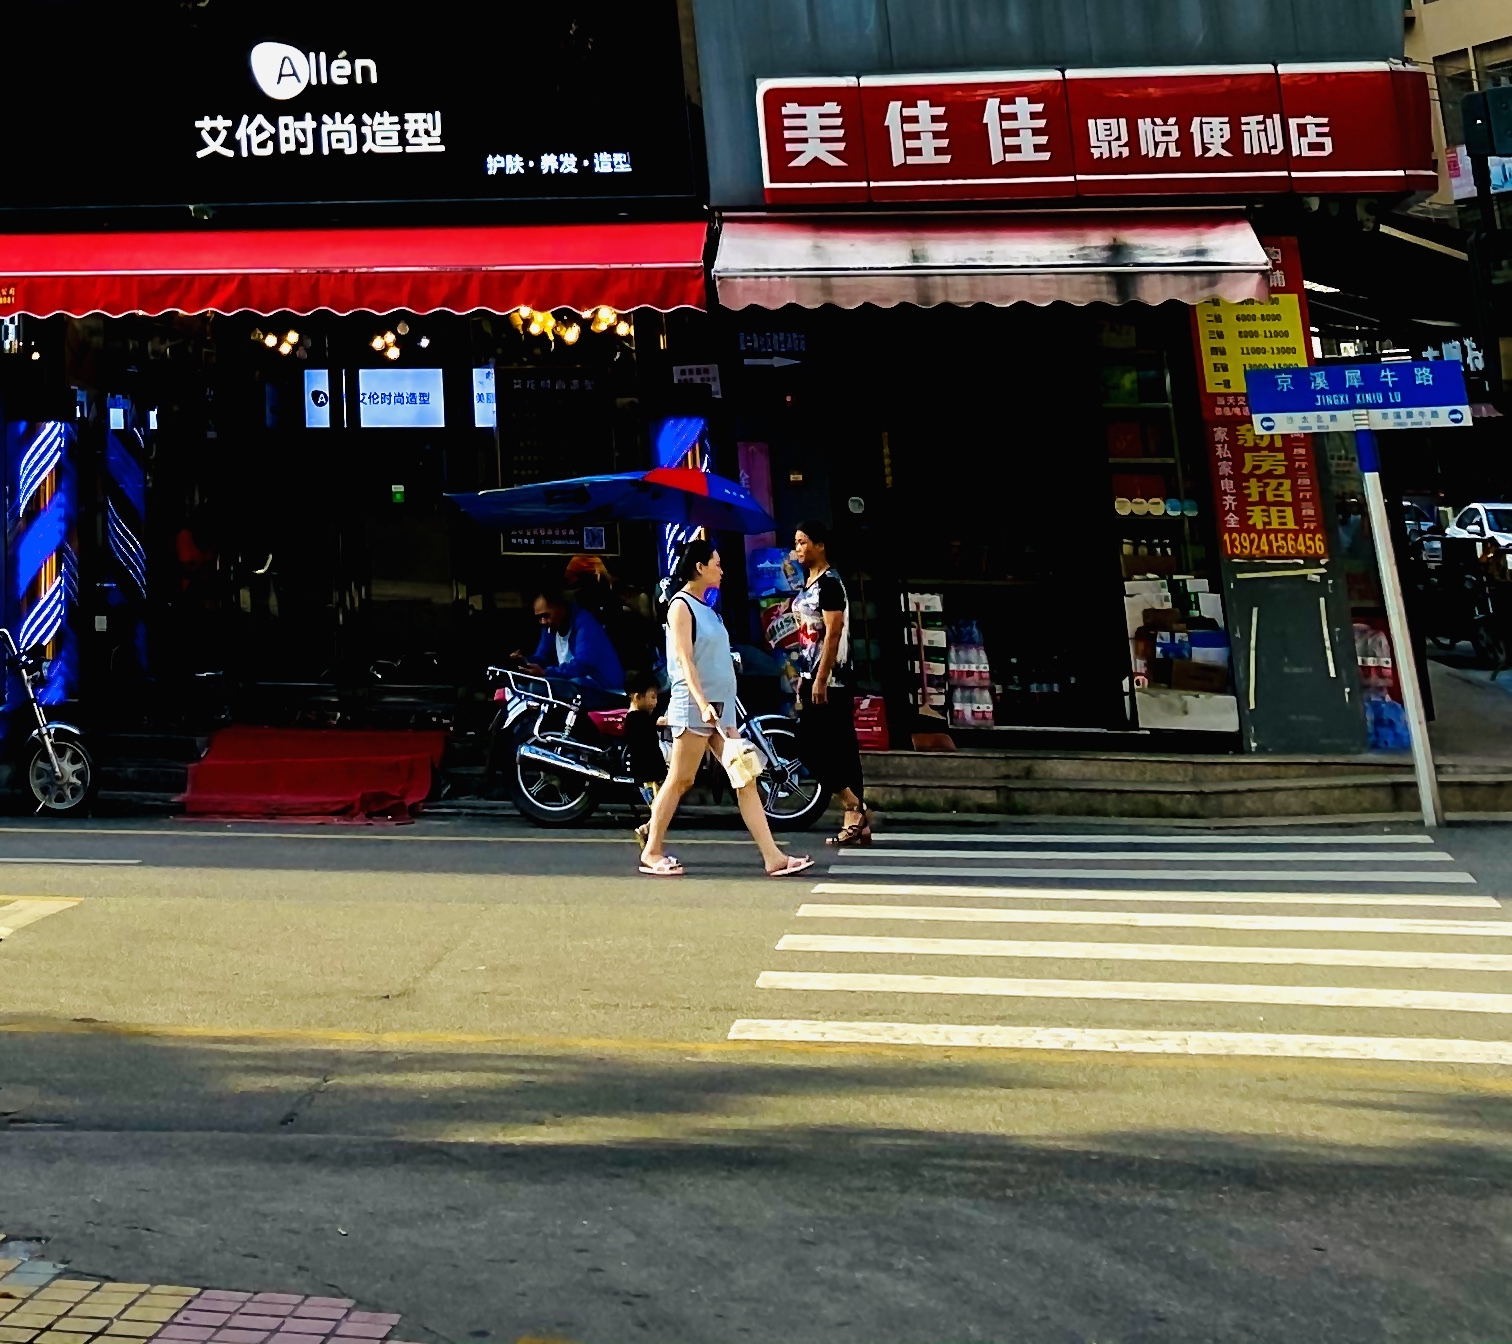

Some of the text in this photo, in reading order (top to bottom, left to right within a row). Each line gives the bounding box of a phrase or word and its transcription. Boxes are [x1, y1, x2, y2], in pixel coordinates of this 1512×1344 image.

[195, 111, 445, 160] 艾伦时尚造型
[780, 96, 1052, 167] 美佳佳
[1087, 113, 1334, 160] 鼎悦便利店
[1274, 367, 1433, 393] 京溪犀牛路
[1314, 391, 1402, 407] JINGXI XINIU LU
[1212, 426, 1241, 529] 家私家电齐全
[1235, 423, 1300, 530] 新房招租
